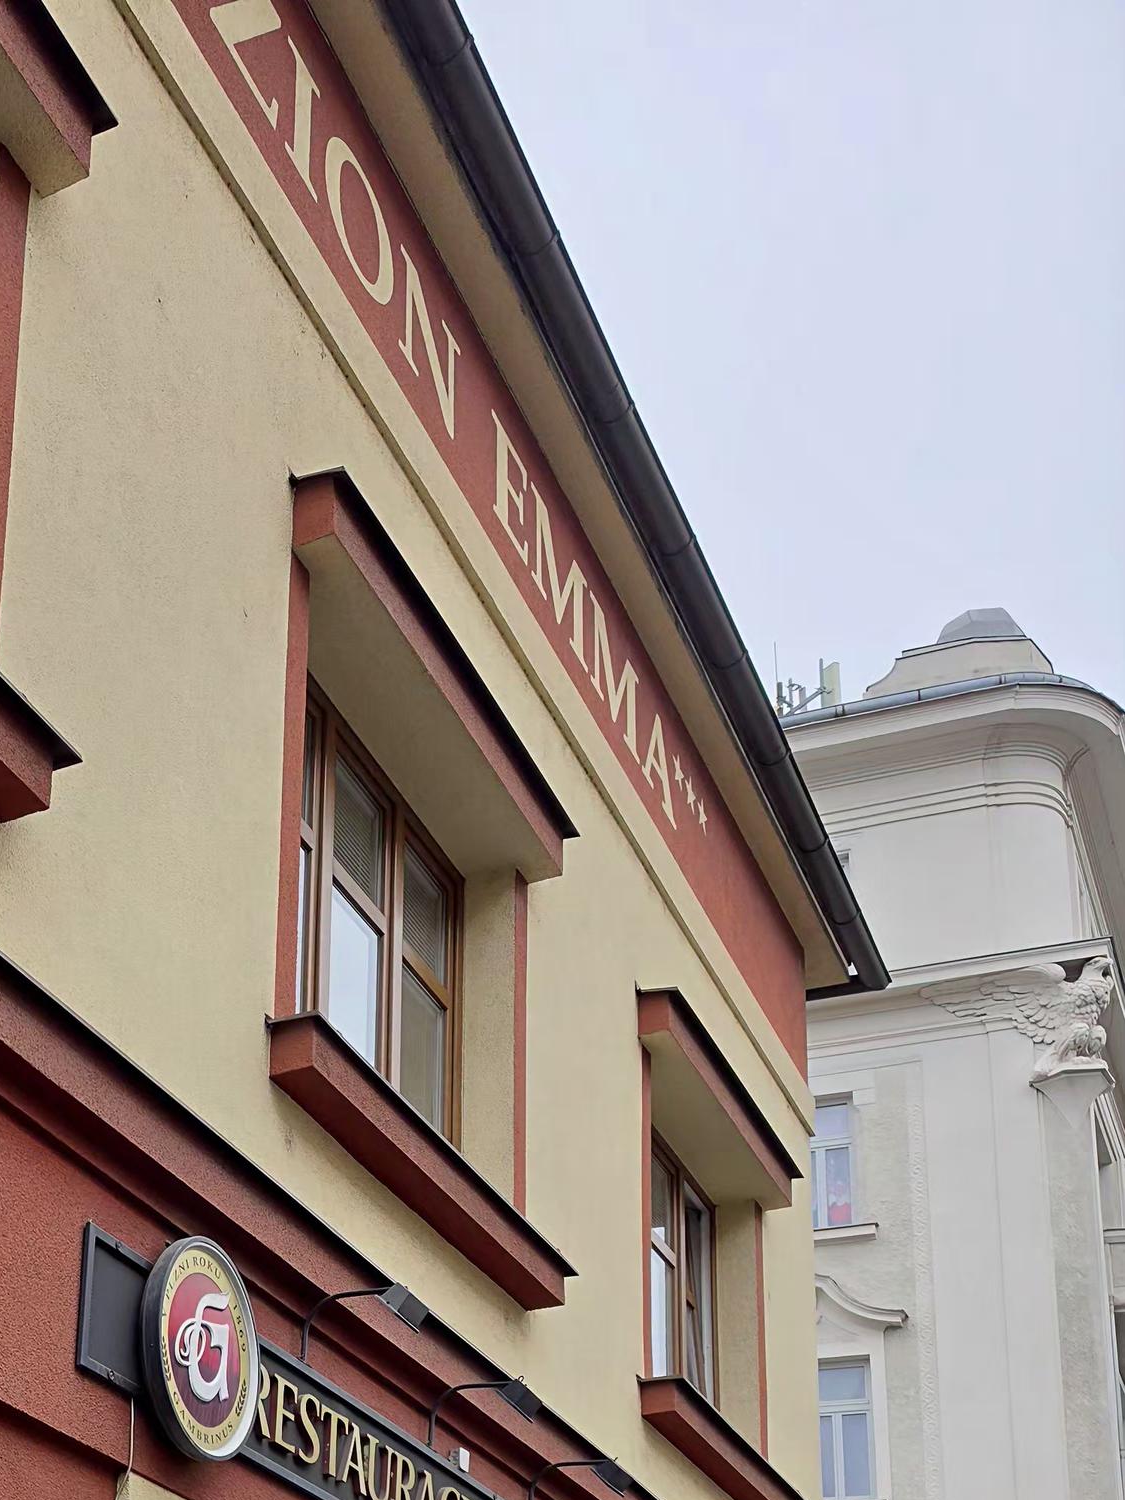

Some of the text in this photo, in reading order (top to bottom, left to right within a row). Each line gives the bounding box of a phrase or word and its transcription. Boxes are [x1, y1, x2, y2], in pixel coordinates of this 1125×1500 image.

[491, 409, 677, 829] EMMA
[192, 1256, 222, 1280] ROKU
[233, 1304, 246, 1353] 1869
[173, 1391, 234, 1445] GAMBRINUS
